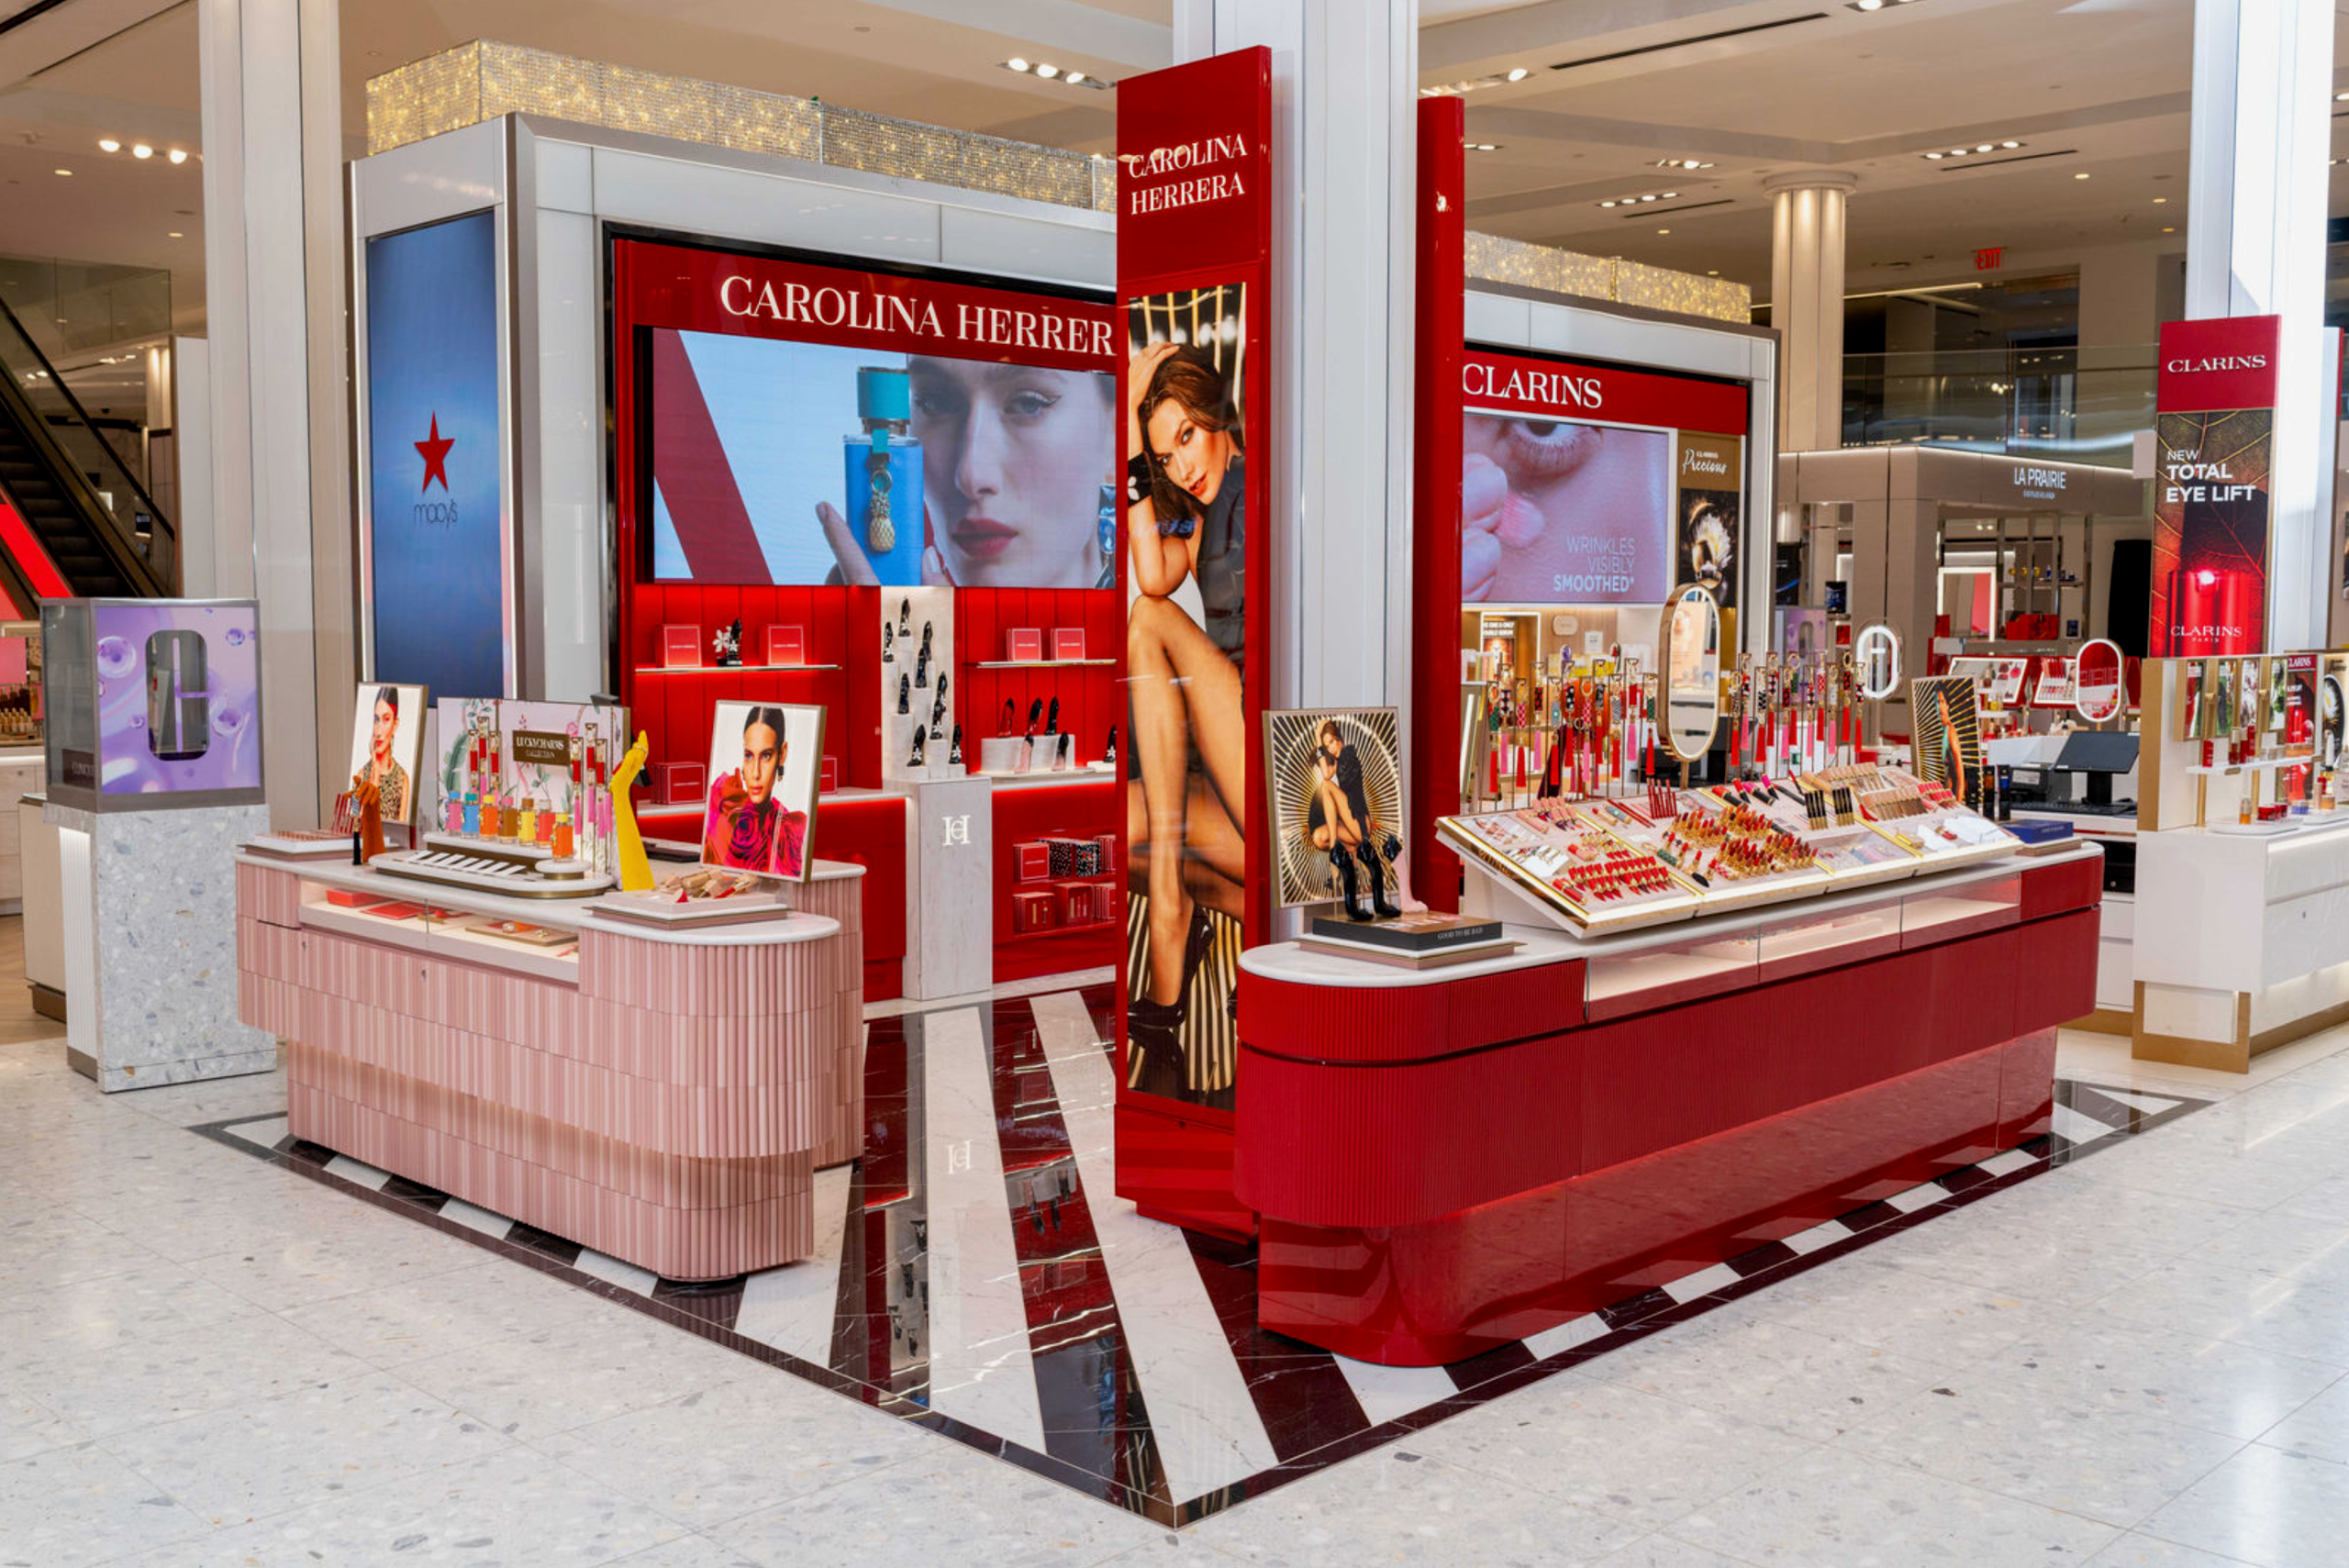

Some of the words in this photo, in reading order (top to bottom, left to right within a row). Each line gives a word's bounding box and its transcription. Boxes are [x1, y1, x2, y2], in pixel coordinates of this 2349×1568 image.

[1129, 133, 1248, 179] CAROLINA
[1130, 172, 1245, 216] HERRERA
[1977, 247, 2002, 270] EXIT
[720, 275, 945, 338] CAROLINA
[957, 304, 1117, 356] HERRER
[2167, 354, 2267, 373] CLARINS
[1463, 363, 1602, 408] CLARINS
[2166, 449, 2200, 461] NEW
[2014, 466, 2026, 485] LA
[2028, 468, 2066, 489] PRAIRIE
[2166, 462, 2232, 481] TOTAL
[2165, 486, 2206, 503] EYE
[2212, 484, 2257, 503] LIFT
[414, 498, 458, 529] macy's
[1565, 536, 1635, 555] WRINKLES
[1586, 555, 1634, 574] VISIBLY
[2171, 626, 2243, 637] CLARINS
